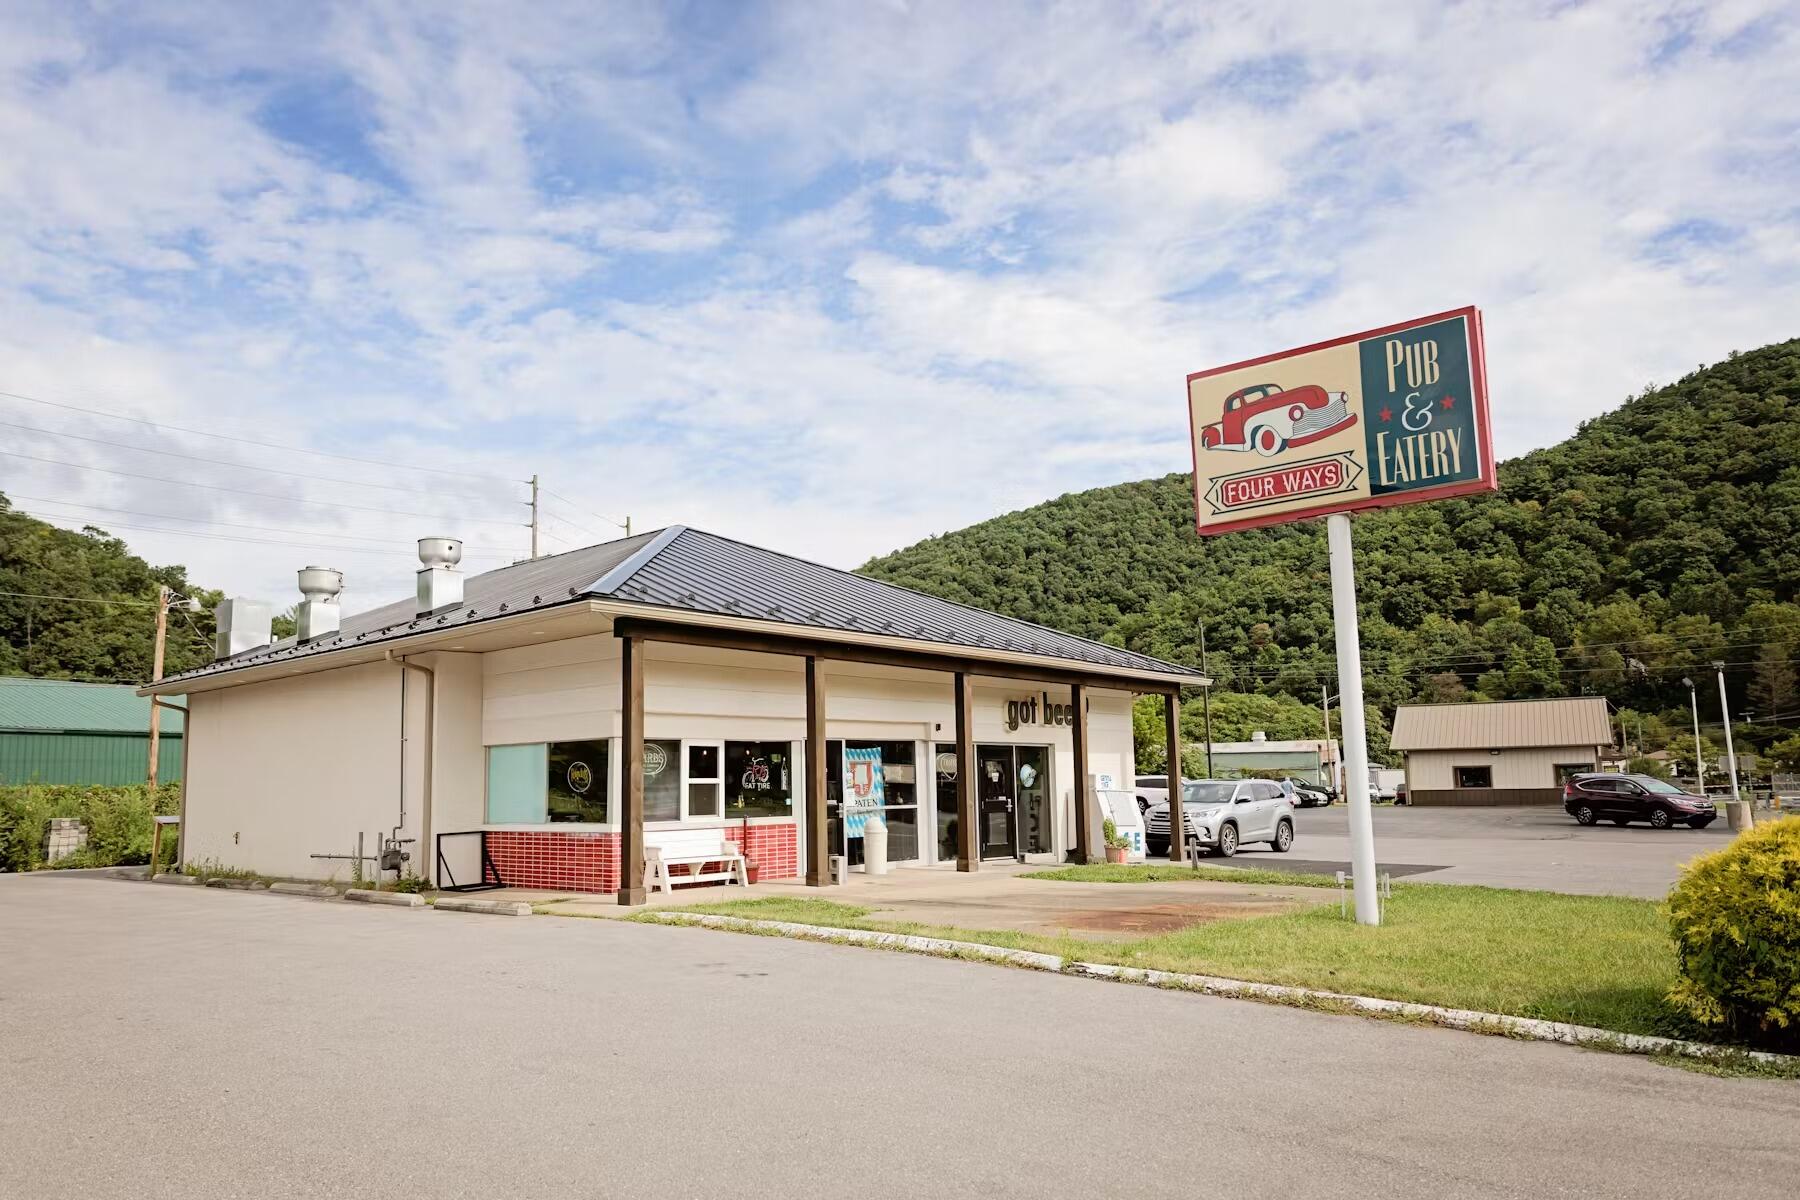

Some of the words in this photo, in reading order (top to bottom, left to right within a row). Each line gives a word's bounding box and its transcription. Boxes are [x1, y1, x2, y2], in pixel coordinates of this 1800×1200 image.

[1385, 339, 1440, 393] PUB
[1401, 391, 1434, 432] &
[1376, 427, 1462, 487] EATERY
[1227, 477, 1276, 504] FOUR
[1282, 465, 1337, 493] WAYS
[1004, 696, 1038, 731] got
[1042, 691, 1089, 726] bee
